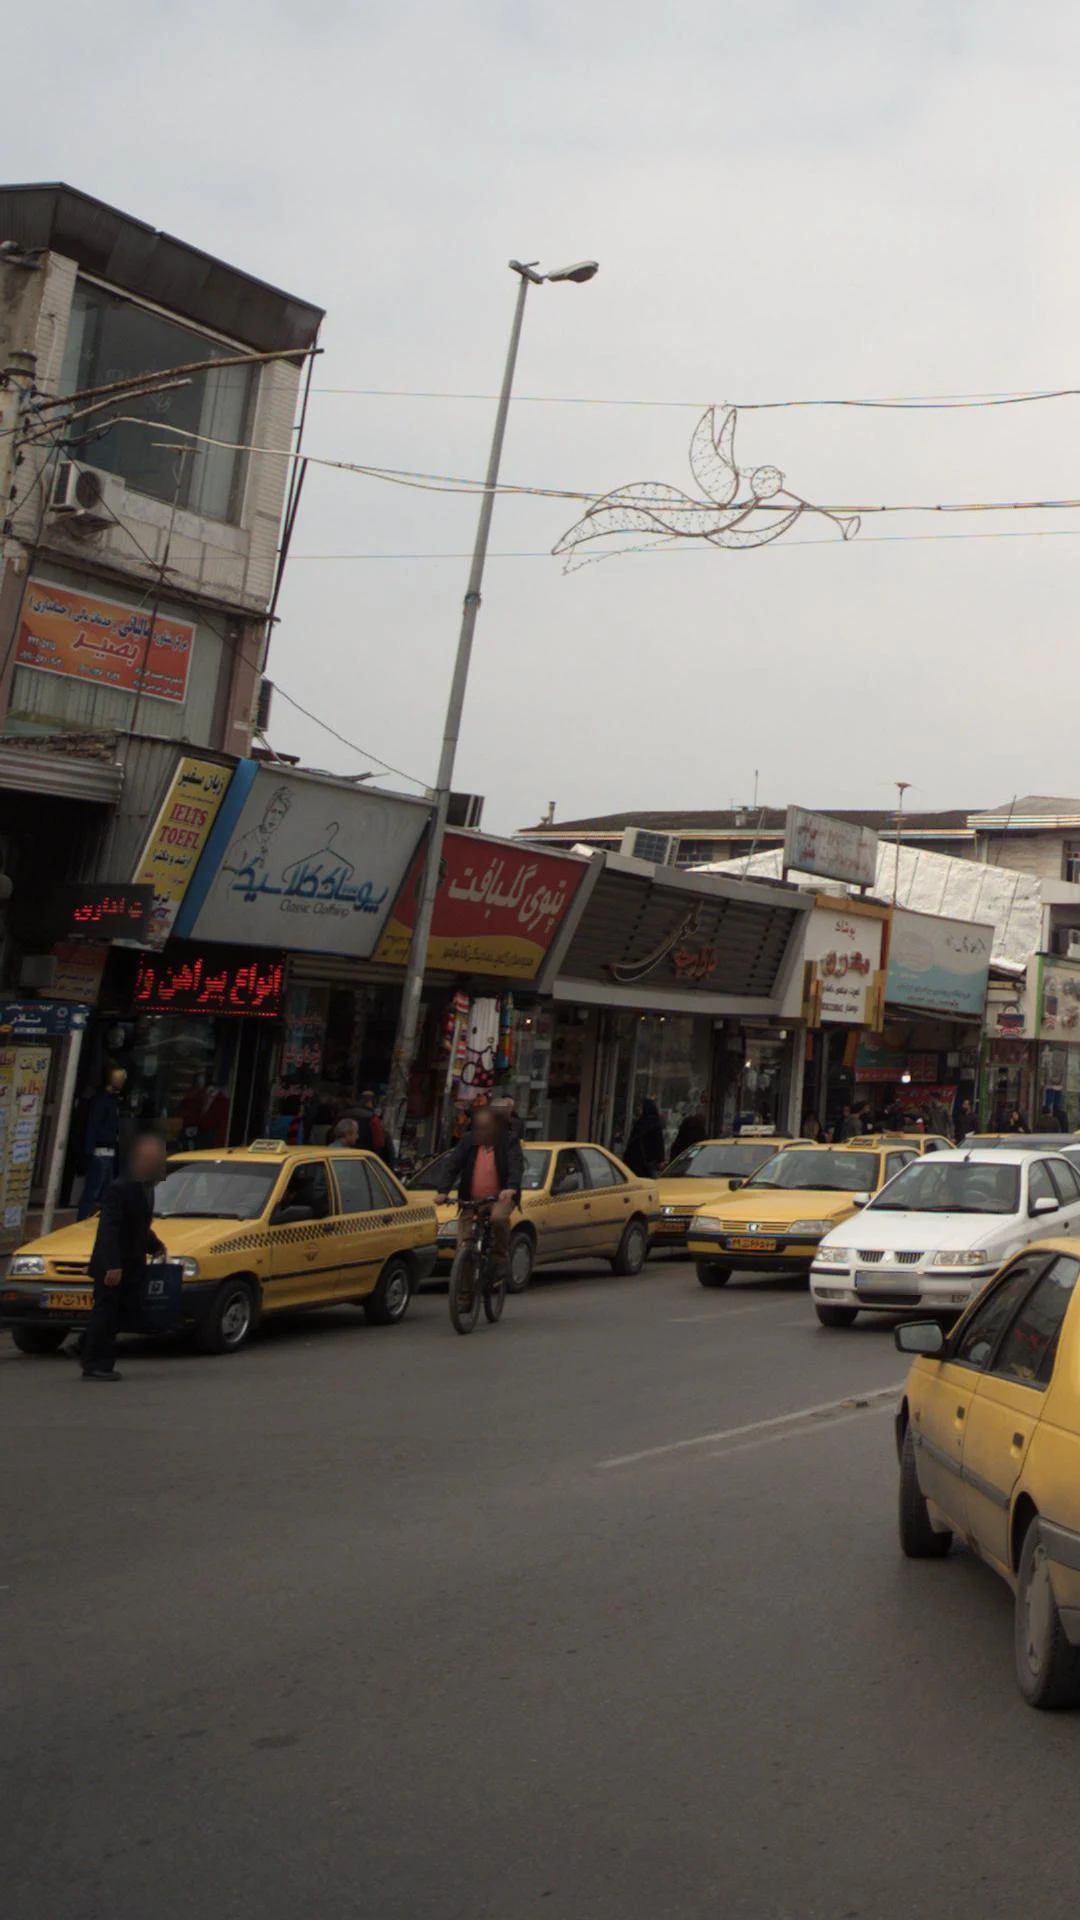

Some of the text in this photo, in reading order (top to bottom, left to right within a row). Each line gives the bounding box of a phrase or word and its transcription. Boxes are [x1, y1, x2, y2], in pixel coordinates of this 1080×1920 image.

[73, 632, 140, 666] بصیر
[178, 766, 224, 796] زبان سفیر
[171, 802, 208, 827] IELTS
[158, 825, 201, 850] TOEFL
[230, 856, 390, 914] پوشاک کلاسیک
[449, 857, 569, 934] پتوی گلبافت
[157, 957, 229, 1007] پیراهن
[229, 961, 283, 1007] انواع
